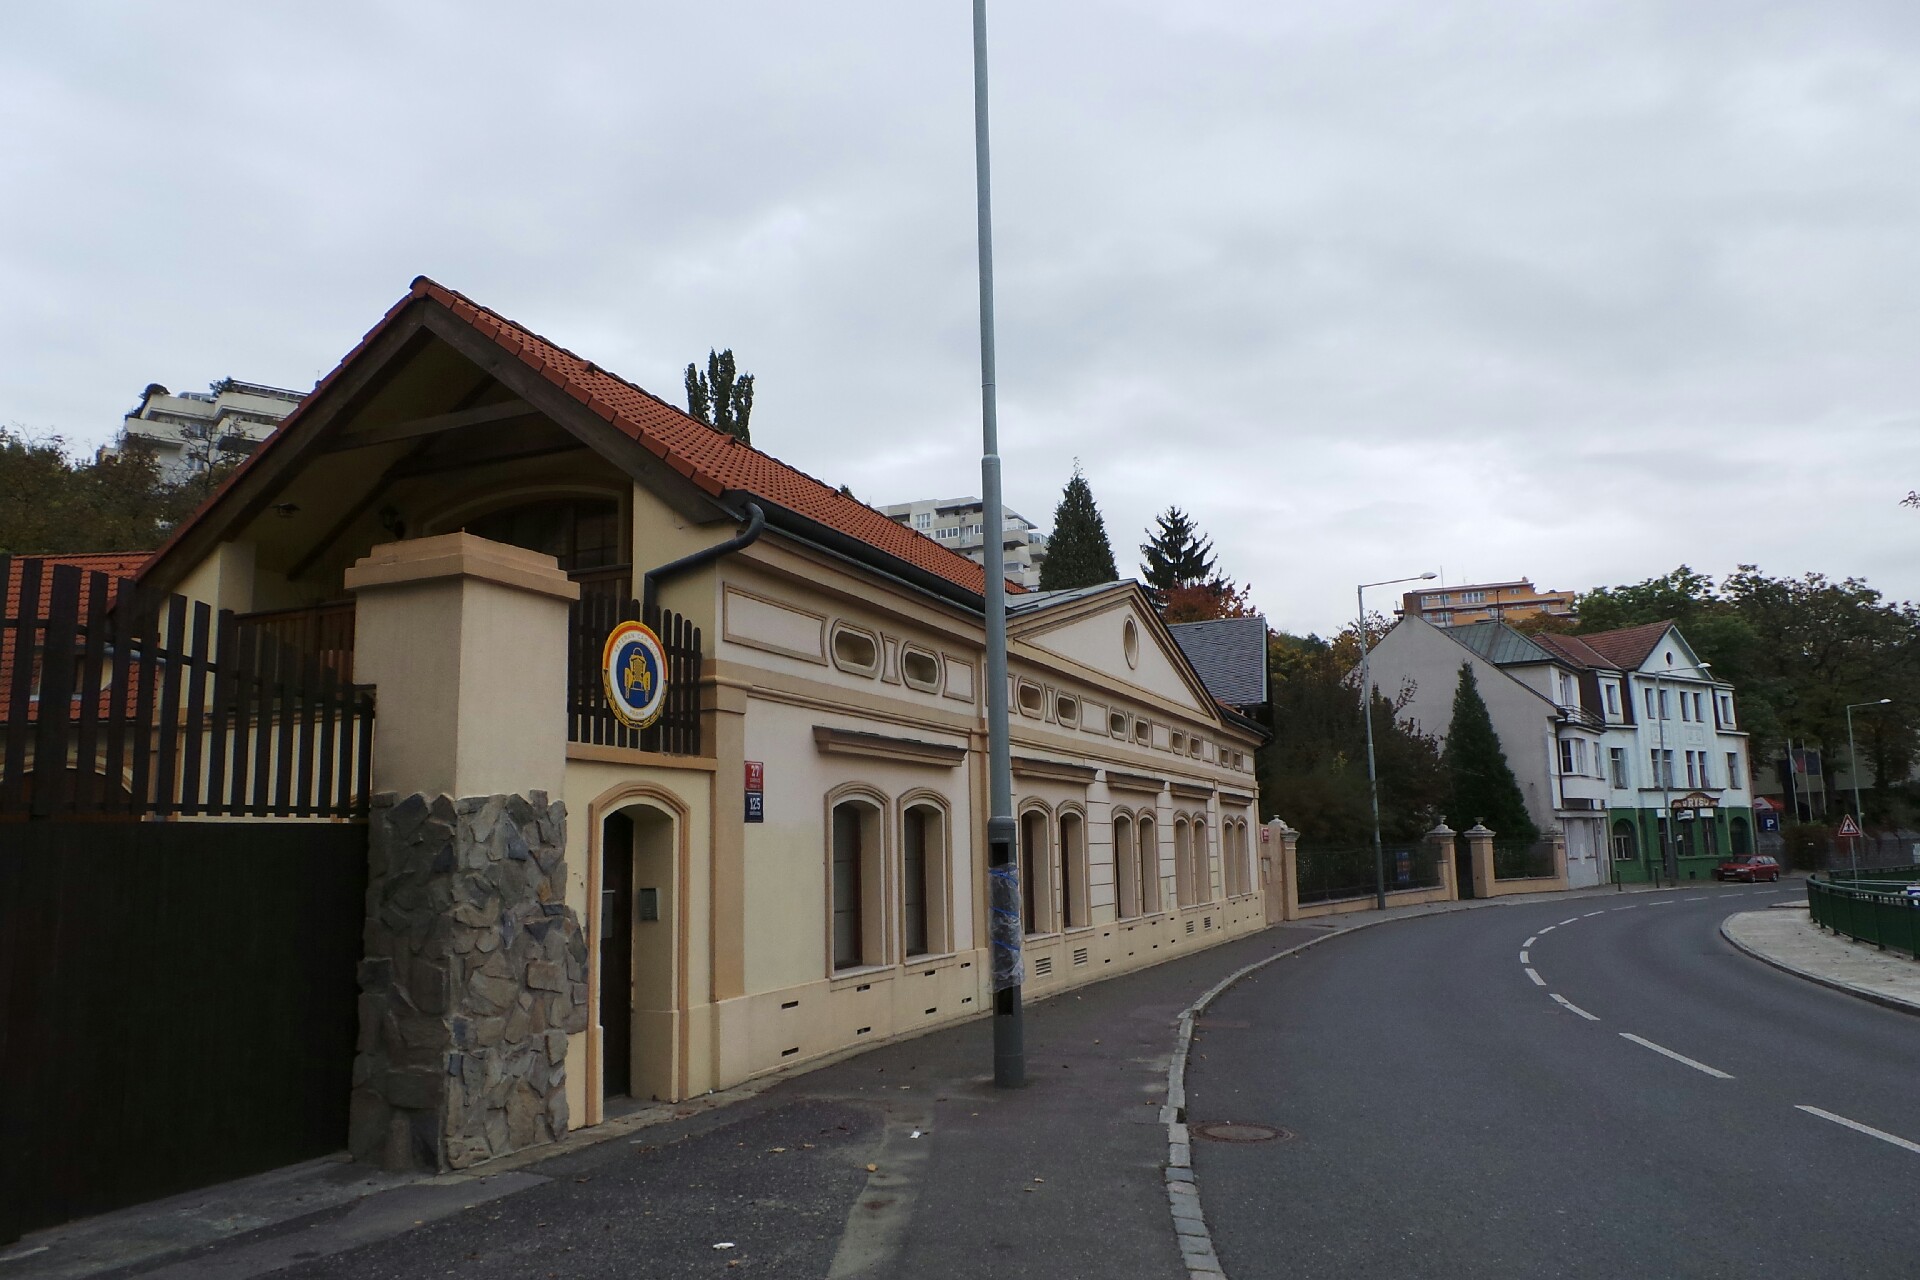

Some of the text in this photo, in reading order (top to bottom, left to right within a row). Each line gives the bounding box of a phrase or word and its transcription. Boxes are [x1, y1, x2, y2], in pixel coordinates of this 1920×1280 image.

[751, 765, 760, 777] 27
[749, 797, 760, 810] 125
[1766, 819, 1774, 828] P
